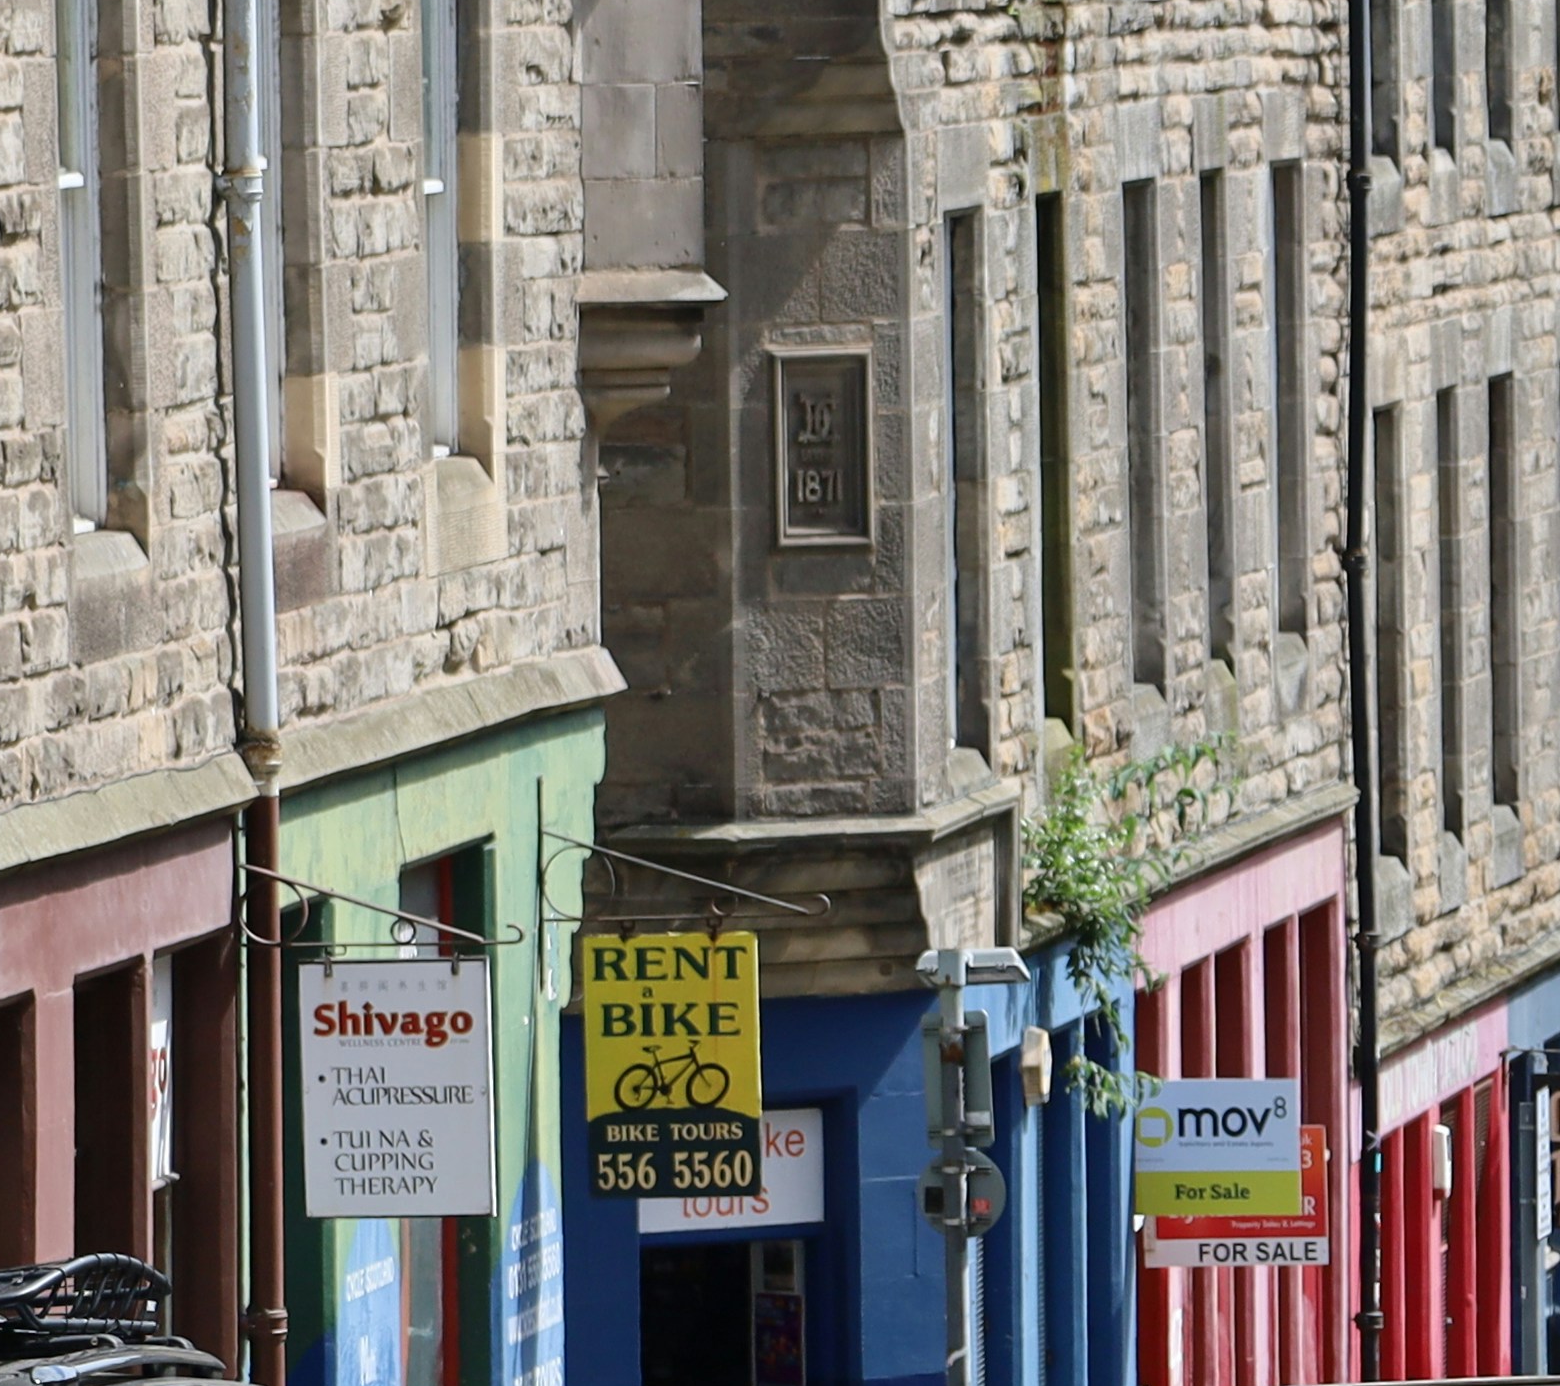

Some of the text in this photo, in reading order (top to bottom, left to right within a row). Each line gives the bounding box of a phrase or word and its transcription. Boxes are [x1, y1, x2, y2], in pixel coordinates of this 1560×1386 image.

[592, 945, 748, 982] RENT
[642, 985, 654, 999] a
[313, 1000, 474, 1049] Shivago
[600, 1001, 742, 1038] BIKE
[340, 1038, 385, 1048] WELLNESS
[331, 1066, 386, 1085] THAI
[333, 1085, 475, 1106] ACUPRESSURE
[333, 1129, 435, 1150] TUI NA &
[606, 1122, 743, 1143] BIKE TOURS
[334, 1151, 435, 1173] CUPPING
[597, 1149, 753, 1191] 556 5560
[335, 1175, 438, 1196] THERAPY
[1174, 1181, 1251, 1201] For Sale
[1198, 1241, 1319, 1263] FOR SALE
